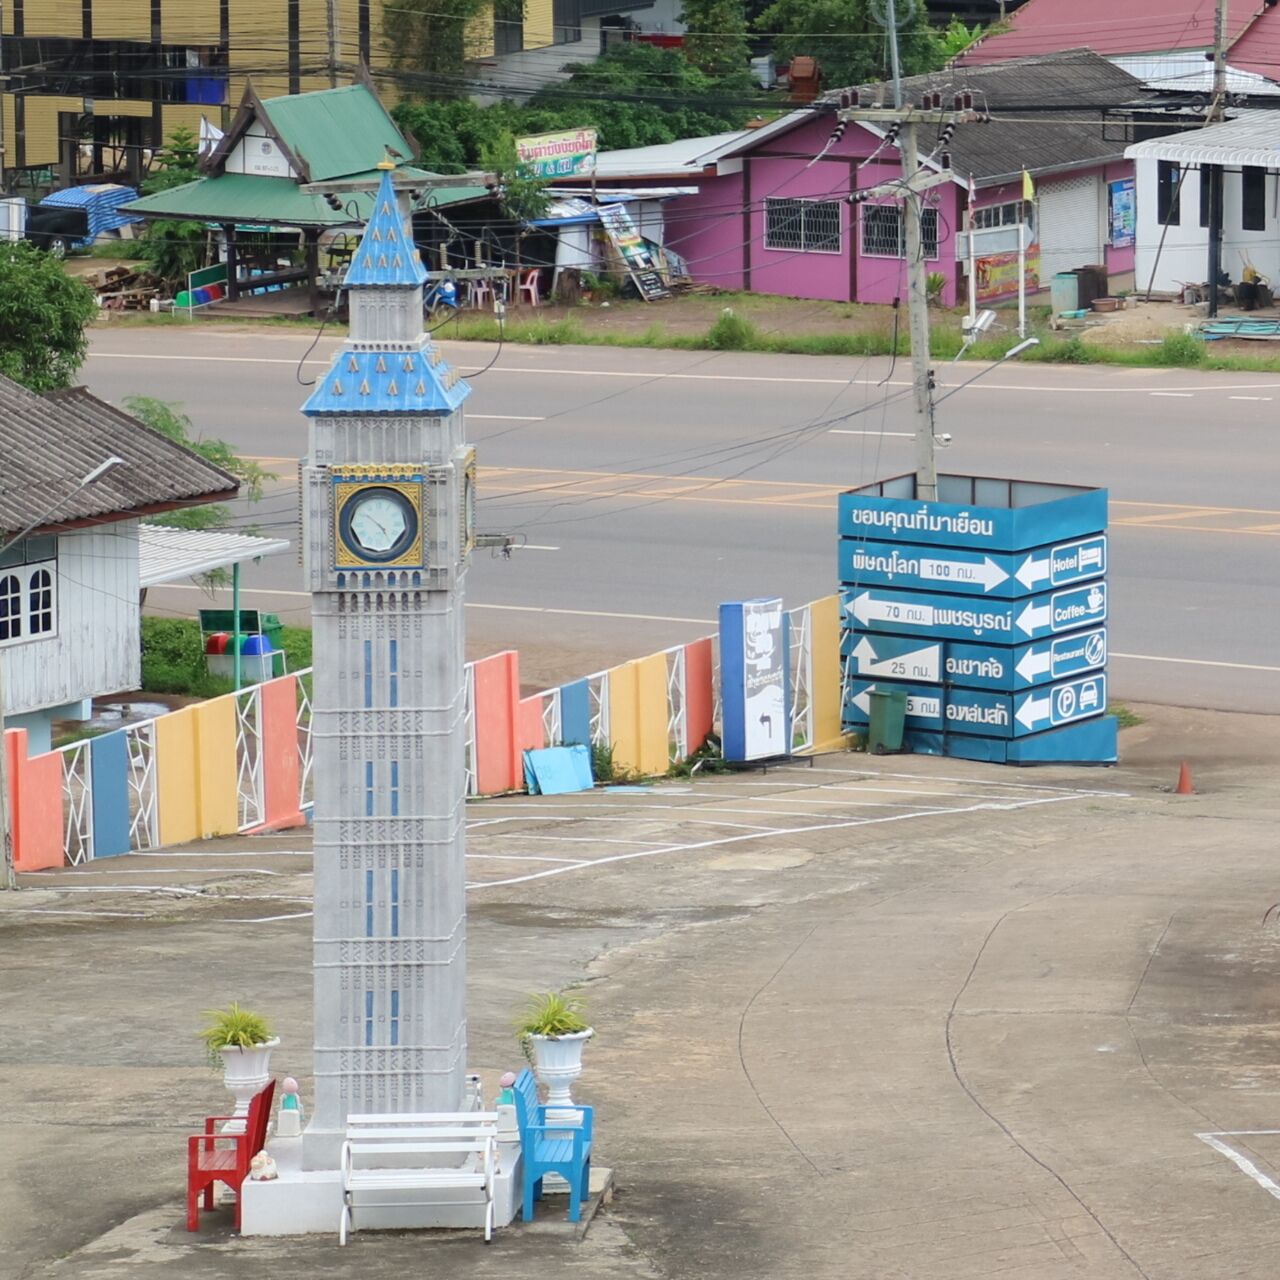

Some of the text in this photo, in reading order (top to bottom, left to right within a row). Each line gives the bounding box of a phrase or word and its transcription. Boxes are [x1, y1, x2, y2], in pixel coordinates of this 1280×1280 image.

[852, 505, 993, 536] ขอบคุณที่มาเยือน
[853, 550, 976, 580] พิษณุโลก 100 กม.
[1053, 554, 1077, 573] Hotel
[886, 605, 1012, 635] 70 กม. เพชรบูรณ์
[1055, 605, 1085, 622] Coffee
[891, 657, 1003, 678] 25 กม. อ.เขาค้อ
[920, 704, 939, 715] กม.
